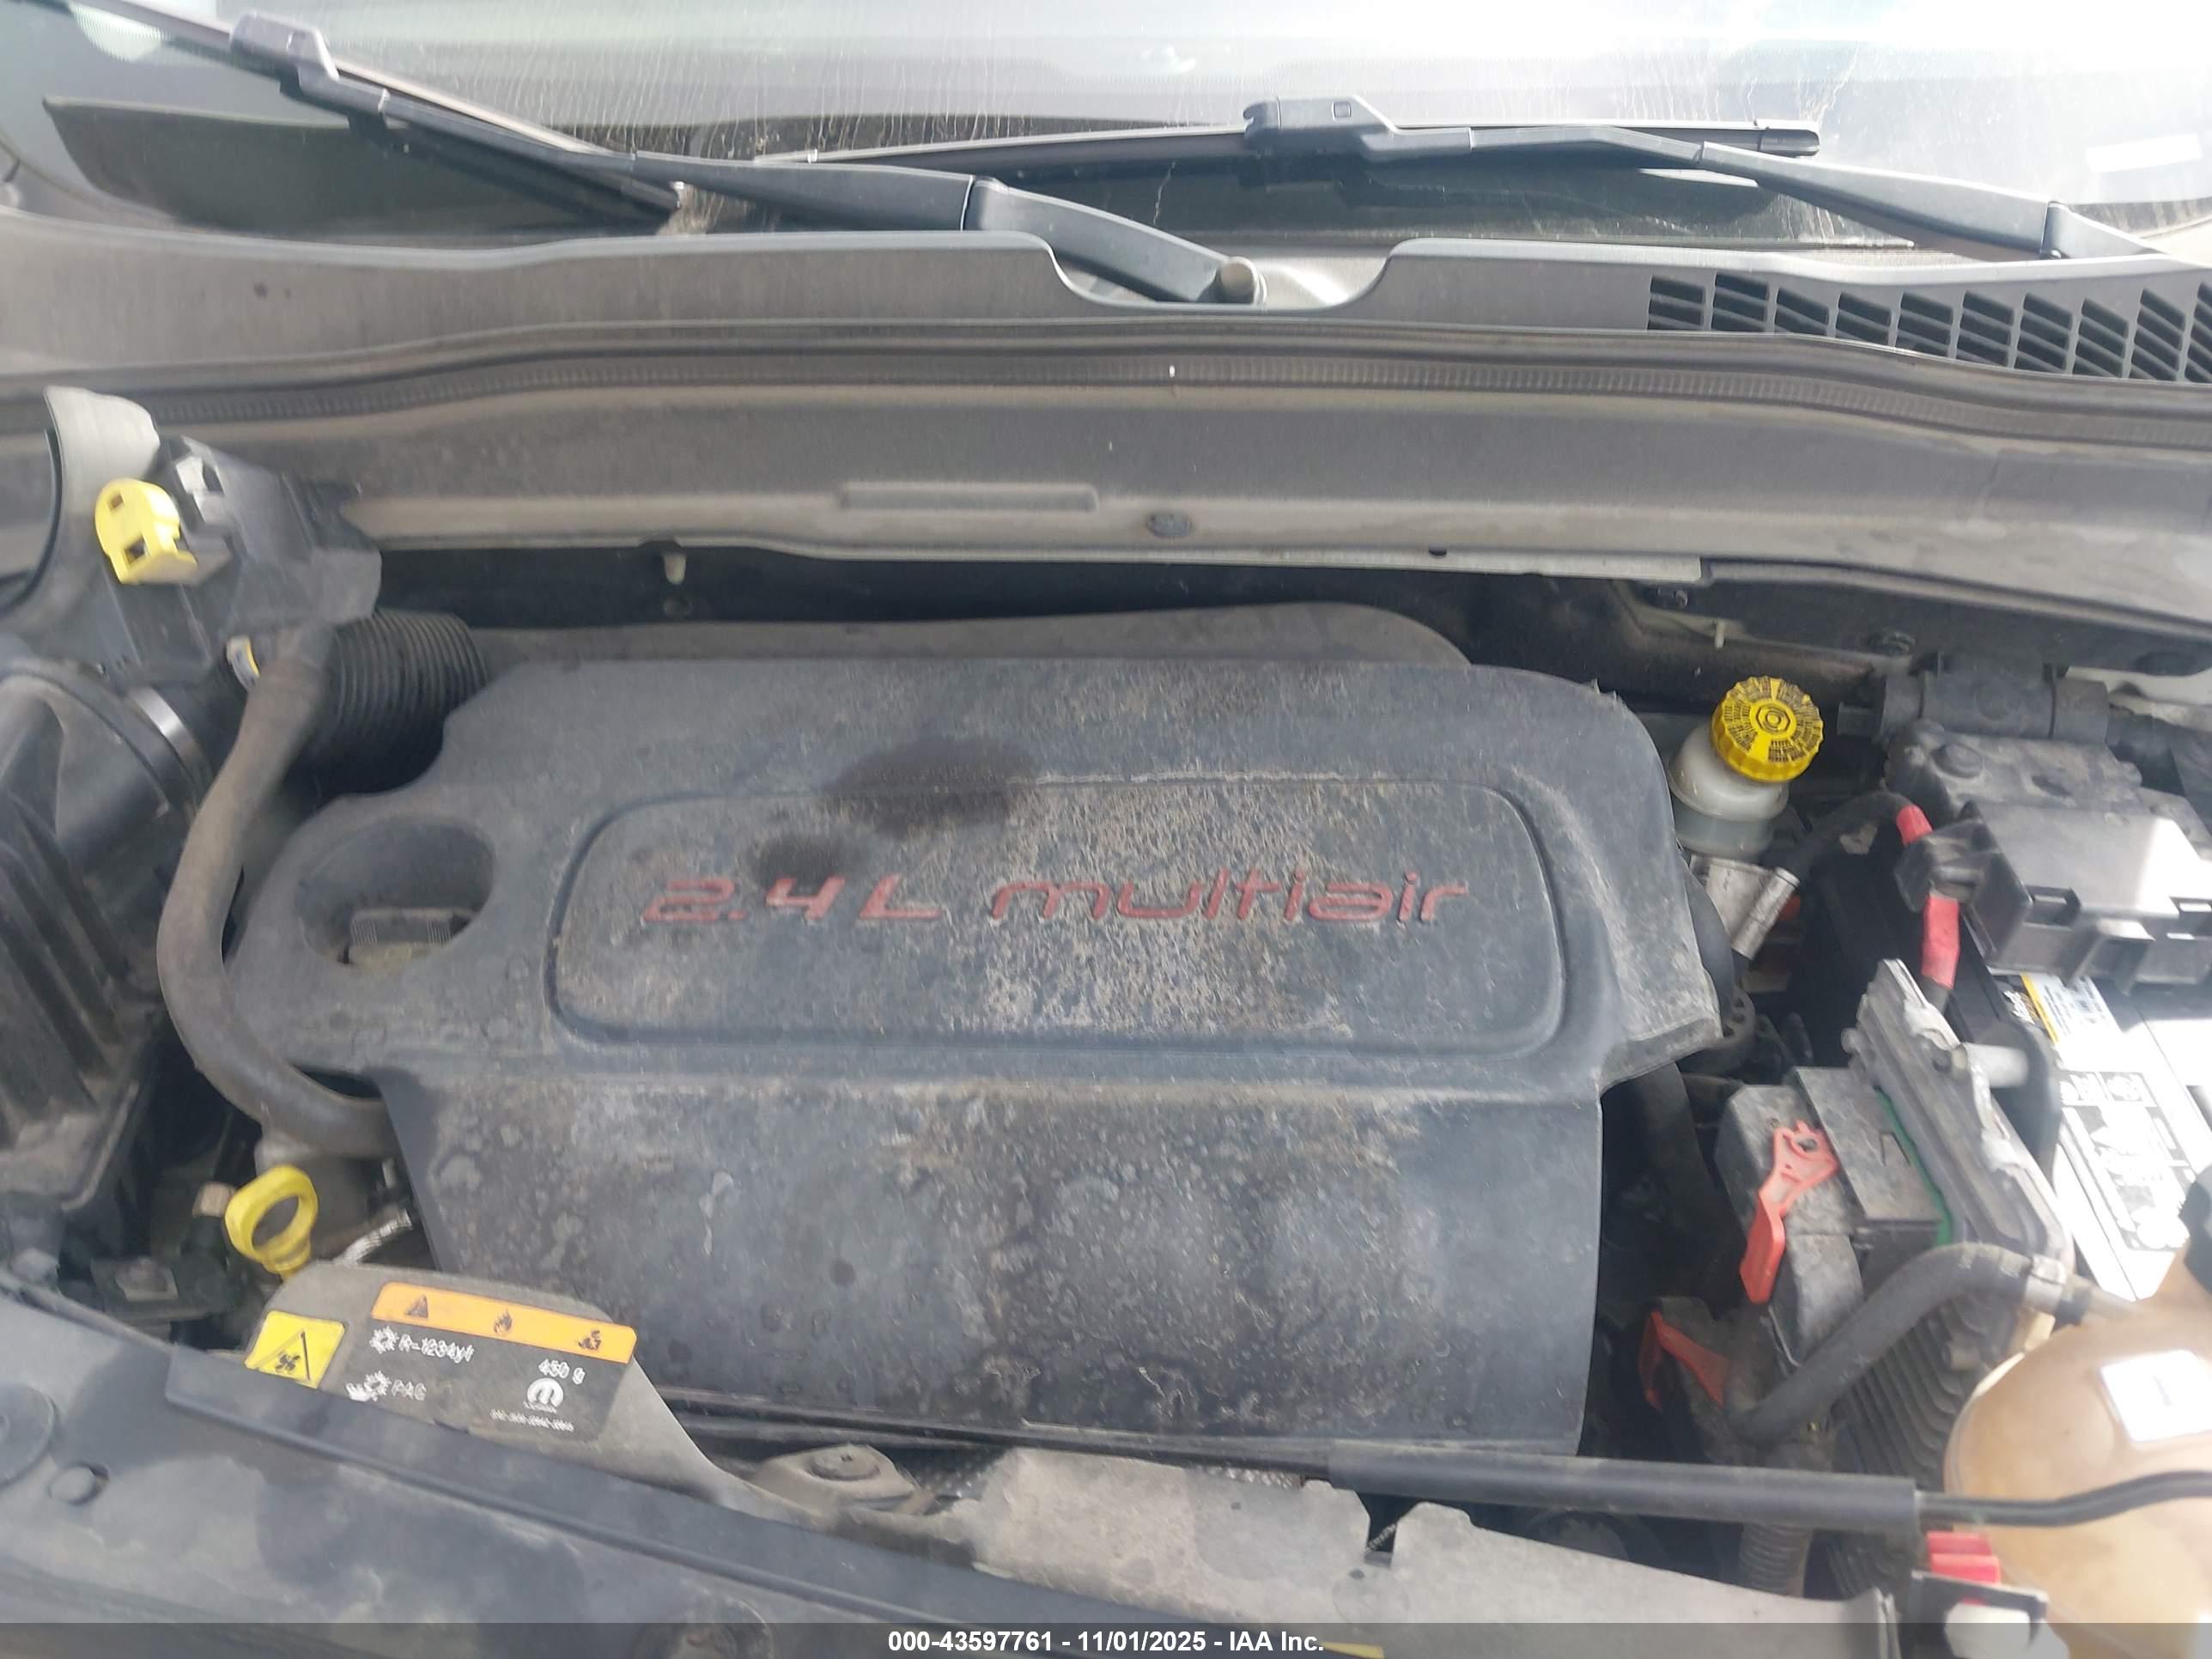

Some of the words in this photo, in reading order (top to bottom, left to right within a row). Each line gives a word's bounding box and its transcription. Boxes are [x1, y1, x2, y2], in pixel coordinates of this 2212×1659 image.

[991, 868, 1468, 922] multiair
[538, 1358, 570, 1379] 450
[572, 1367, 586, 1385] g
